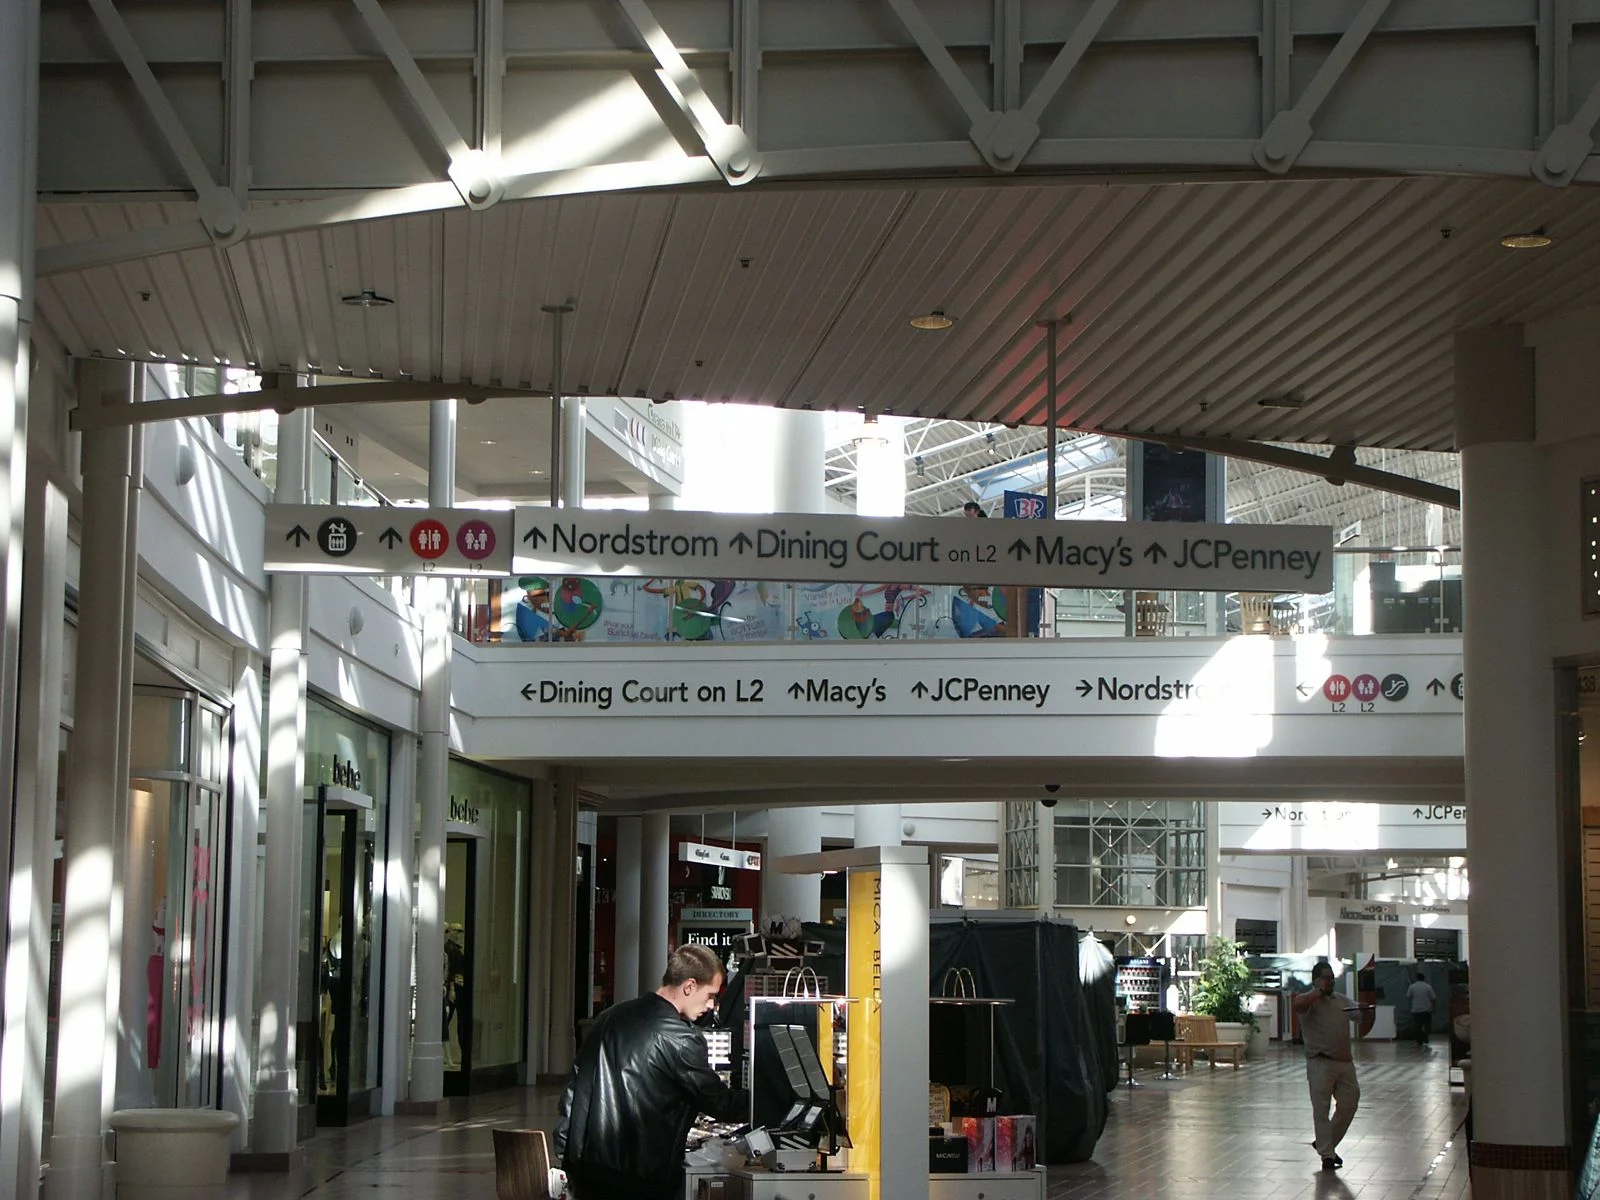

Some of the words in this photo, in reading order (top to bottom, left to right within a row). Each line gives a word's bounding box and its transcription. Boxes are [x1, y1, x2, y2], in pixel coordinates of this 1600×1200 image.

[552, 523, 719, 557] Nordstrom
[757, 528, 848, 569] Dining
[856, 531, 940, 562] Court
[948, 548, 971, 563] on
[976, 544, 1000, 564] L2
[1036, 535, 1134, 576] Macy's
[1173, 538, 1322, 580] JCPenney
[422, 562, 436, 572] L2
[540, 680, 613, 710] Dining
[622, 679, 689, 704] Court
[697, 685, 726, 703] on
[736, 679, 764, 703] L2
[806, 677, 887, 710] Macy's
[931, 677, 1051, 709] JCPenney
[1098, 675, 1226, 701] Nordstr
[1331, 702, 1346, 713] L2
[1360, 702, 1375, 713] L2
[333, 754, 361, 791] bebe
[450, 795, 479, 823] bebe
[770, 921, 784, 935] M
[688, 933, 717, 945] Find
[722, 933, 732, 946] it
[986, 1097, 997, 1113] M
